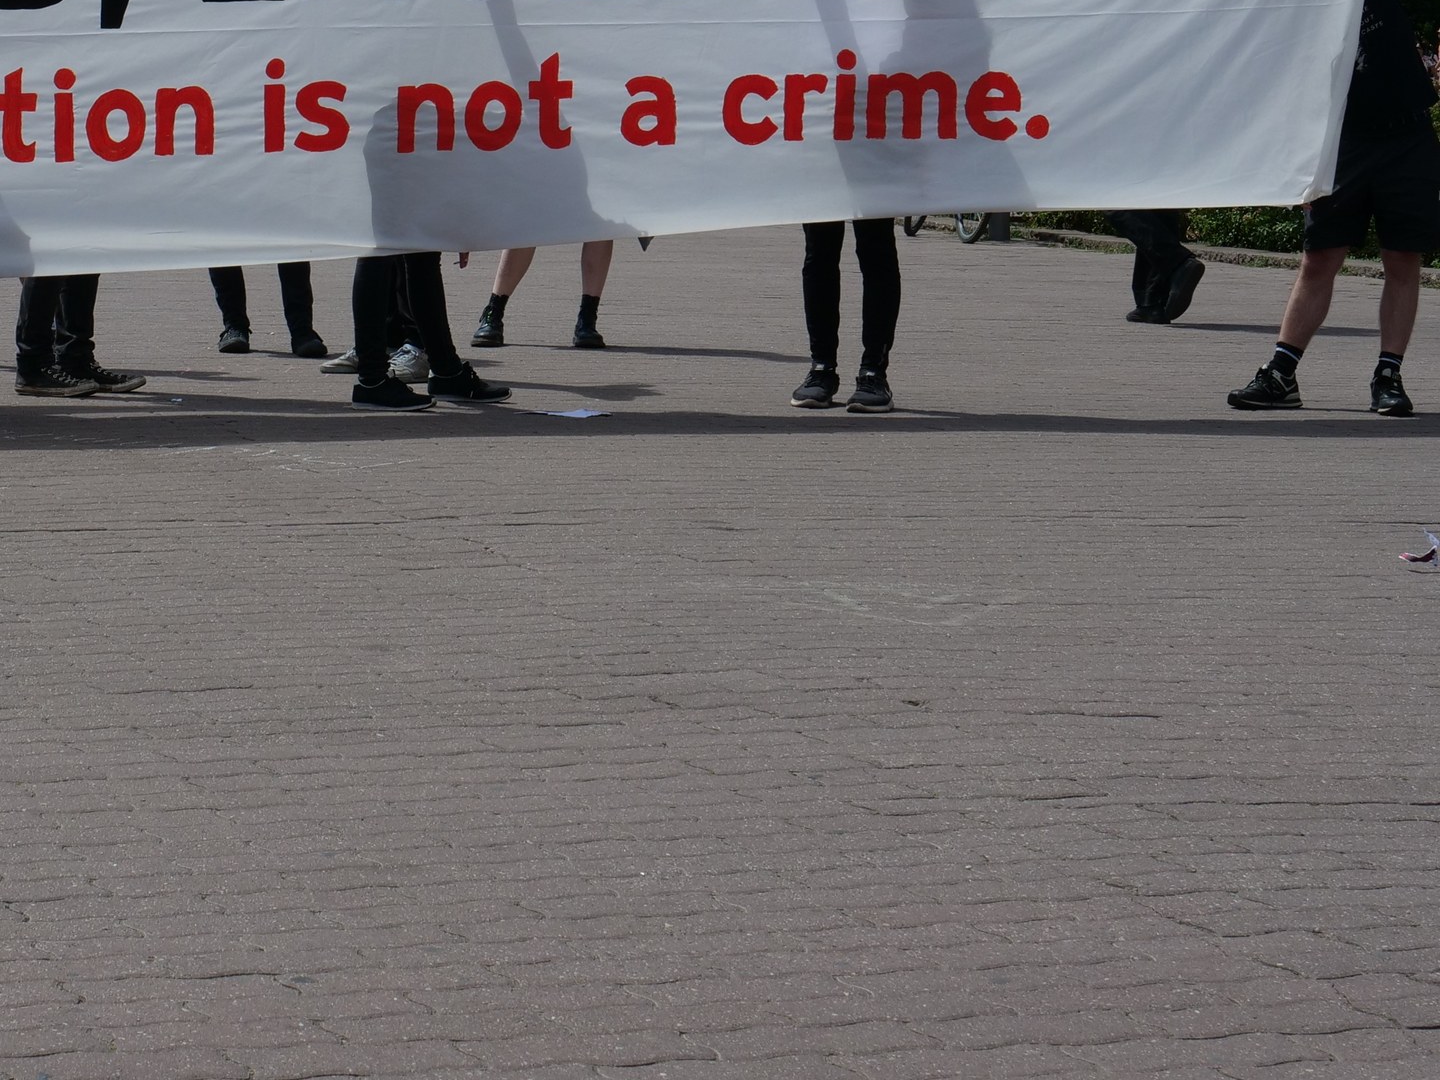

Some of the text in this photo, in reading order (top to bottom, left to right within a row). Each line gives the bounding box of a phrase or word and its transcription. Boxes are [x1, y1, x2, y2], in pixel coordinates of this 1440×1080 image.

[264, 58, 351, 153] is
[397, 52, 574, 153] not
[620, 75, 677, 146] a
[722, 48, 1050, 146] crime.
